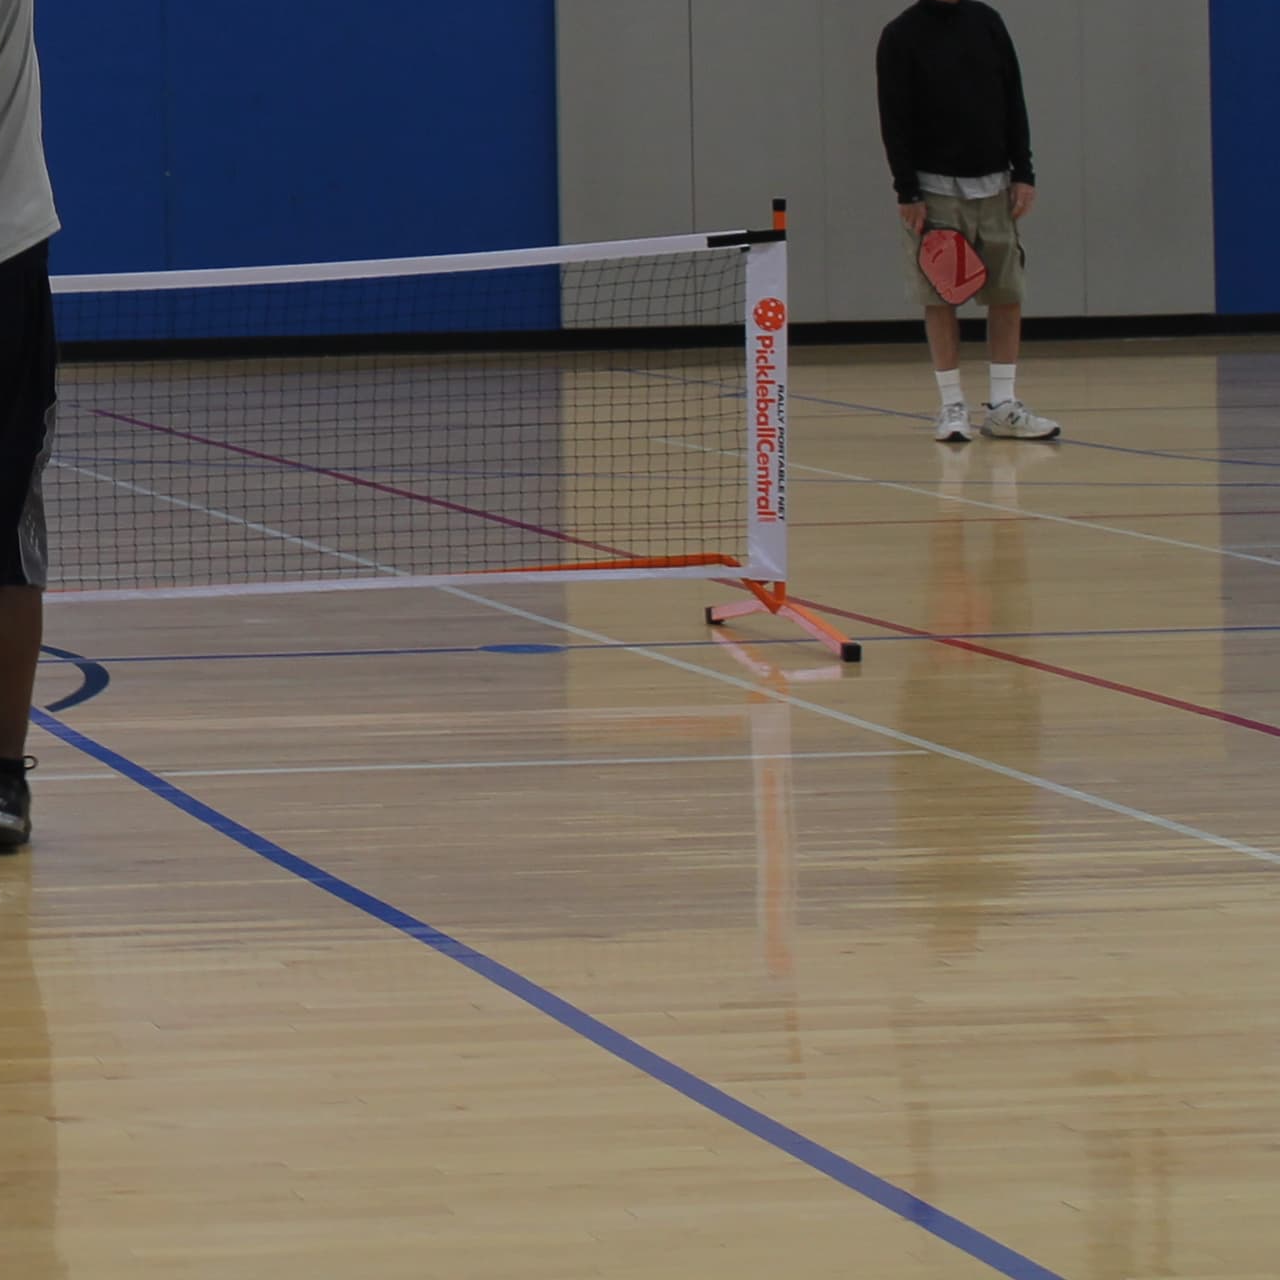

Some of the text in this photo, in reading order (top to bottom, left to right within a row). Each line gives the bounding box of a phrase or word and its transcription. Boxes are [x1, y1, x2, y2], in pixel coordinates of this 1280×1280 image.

[755, 335, 776, 516] PickleballCentral
[777, 384, 785, 521] RALLY PORTABLE NET
